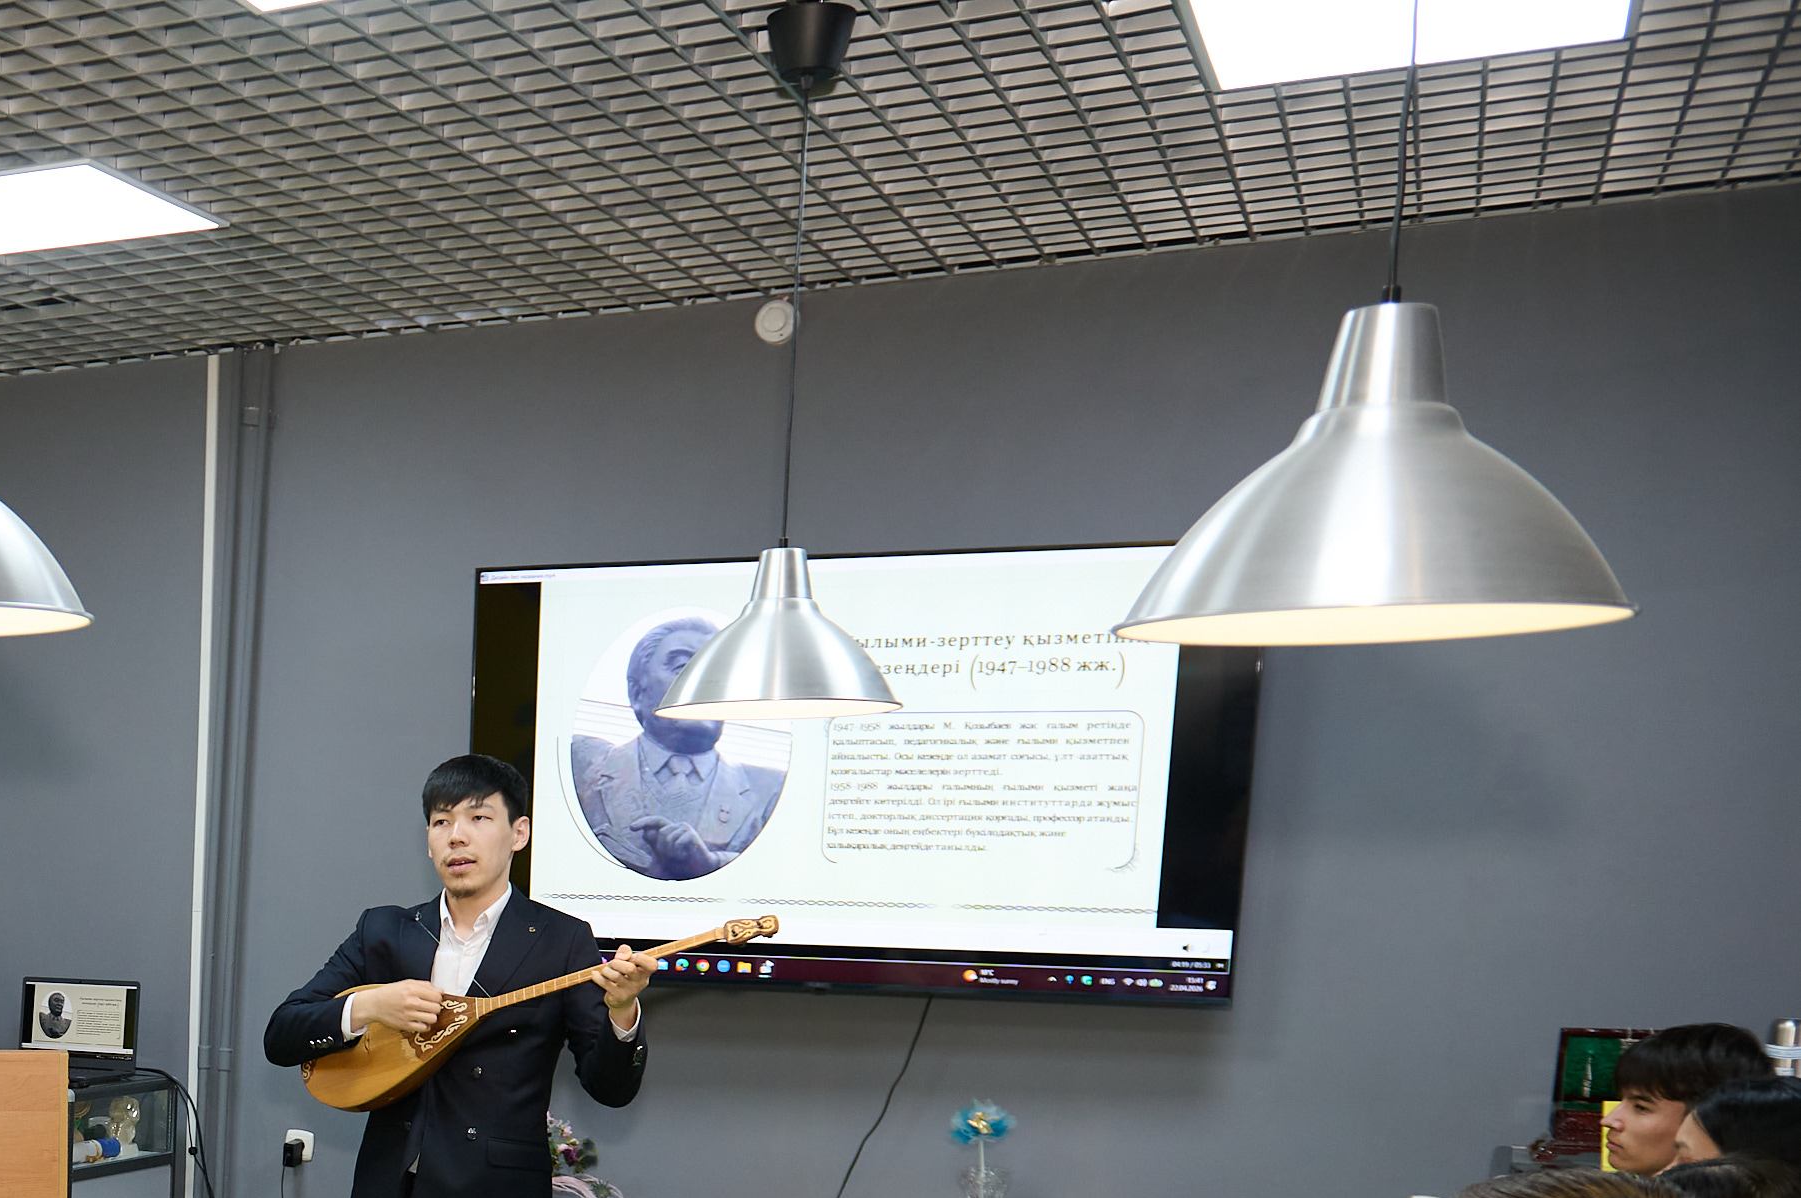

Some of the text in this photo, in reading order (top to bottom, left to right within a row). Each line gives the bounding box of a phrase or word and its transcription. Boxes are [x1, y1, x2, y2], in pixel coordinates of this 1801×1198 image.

[851, 632, 1149, 649] ылыми-зерттеу қызметі
[876, 660, 959, 677] зеңдері
